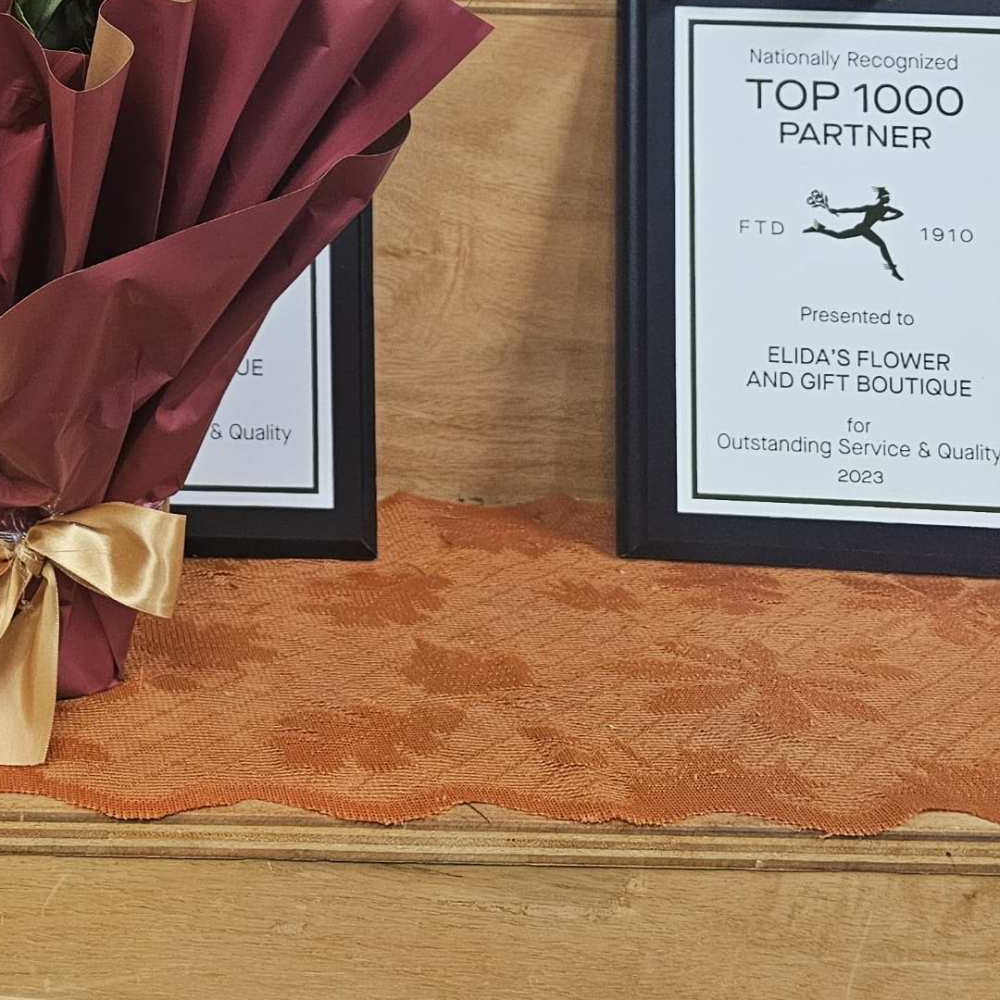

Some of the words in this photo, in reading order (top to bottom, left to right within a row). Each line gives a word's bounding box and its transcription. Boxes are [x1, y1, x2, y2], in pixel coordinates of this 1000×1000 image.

[749, 48, 840, 71] Nationally
[847, 51, 959, 74] Recognized
[745, 78, 841, 112] TOP
[853, 83, 964, 117] 1000
[779, 121, 933, 150] PARTNER
[739, 219, 785, 236] FTD
[920, 227, 974, 243] 1910
[800, 305, 892, 326] Presented
[896, 309, 915, 327] to
[236, 358, 264, 377] UE
[767, 345, 851, 367] ELIDA'S
[856, 349, 951, 372] FLOWER
[745, 370, 795, 390] AND
[800, 371, 848, 392] GIFT
[856, 374, 973, 398] BOUTIQUE
[210, 422, 223, 440] &
[228, 423, 293, 446] Quality
[846, 417, 872, 434] for
[716, 432, 832, 459] Outstanding
[838, 438, 911, 458] Service
[917, 440, 932, 459] &
[937, 442, 1000, 467] Quality
[837, 468, 885, 485] 2023
